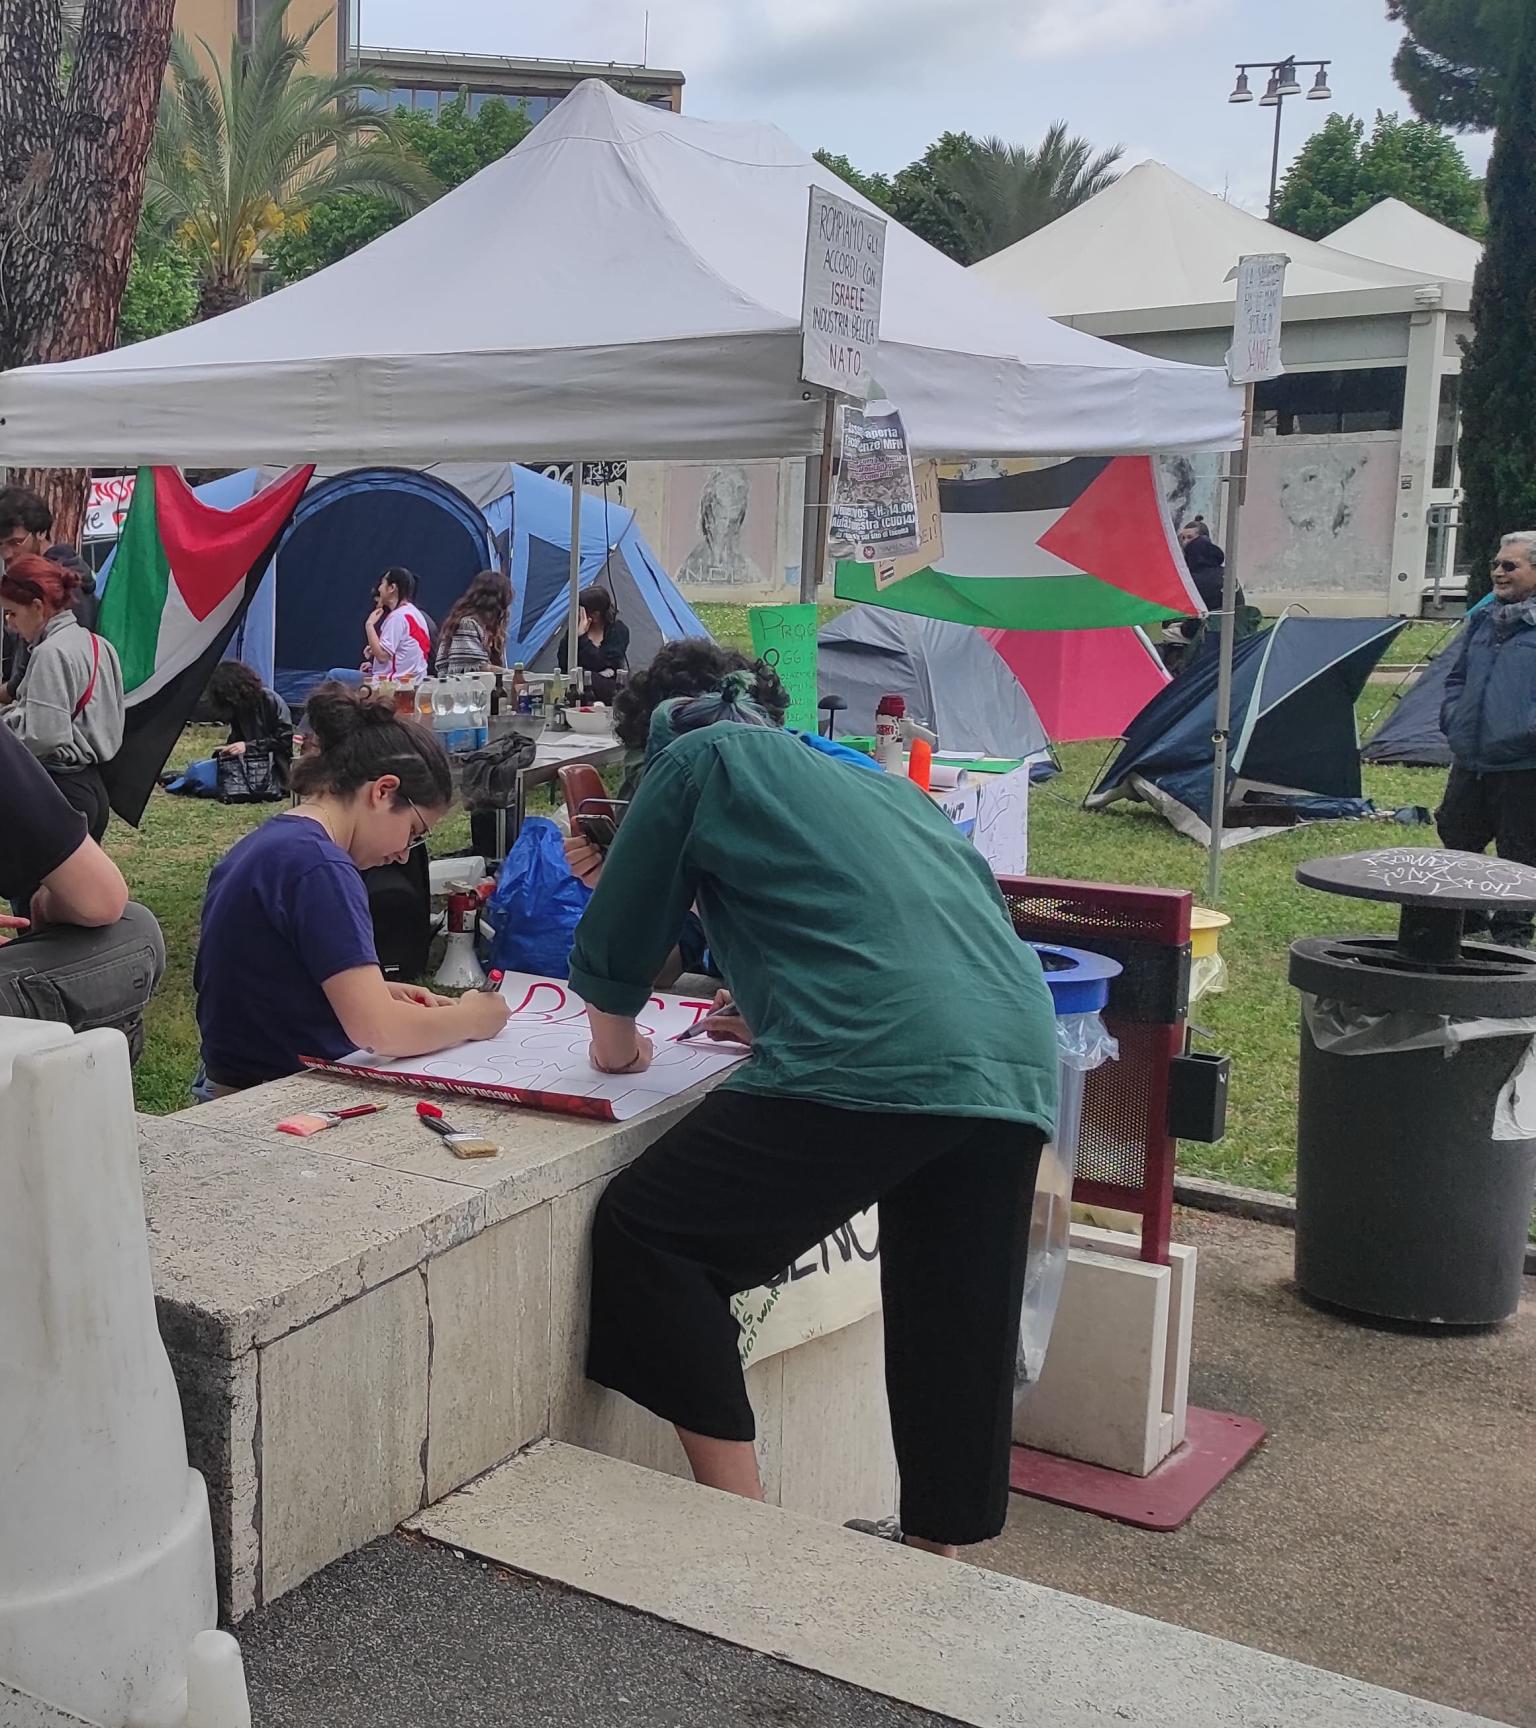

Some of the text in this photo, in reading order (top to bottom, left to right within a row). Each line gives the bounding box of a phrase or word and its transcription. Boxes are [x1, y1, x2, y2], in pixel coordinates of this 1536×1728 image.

[823, 247, 876, 287] ACCORDI CON
[830, 280, 865, 313] ISRAELE
[829, 343, 861, 377] NATO
[756, 1287, 781, 1325] WAR
